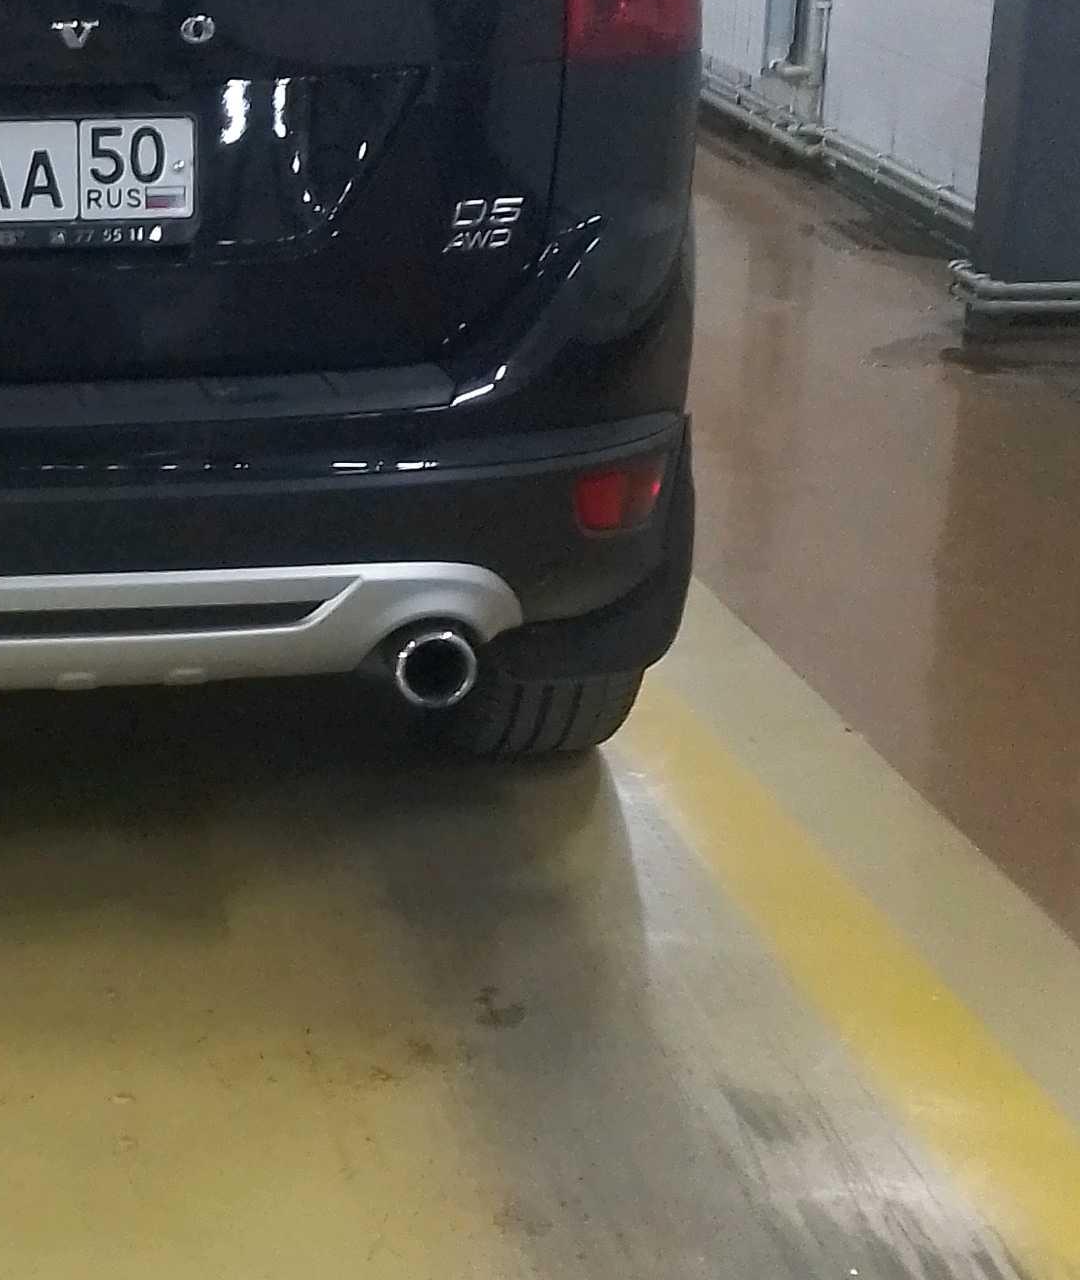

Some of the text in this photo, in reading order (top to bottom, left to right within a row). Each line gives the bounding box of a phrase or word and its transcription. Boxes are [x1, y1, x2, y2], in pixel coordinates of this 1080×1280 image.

[90, 126, 166, 184] 50
[87, 188, 142, 208] RUS
[453, 197, 524, 226] D5
[441, 228, 511, 253] AWD
